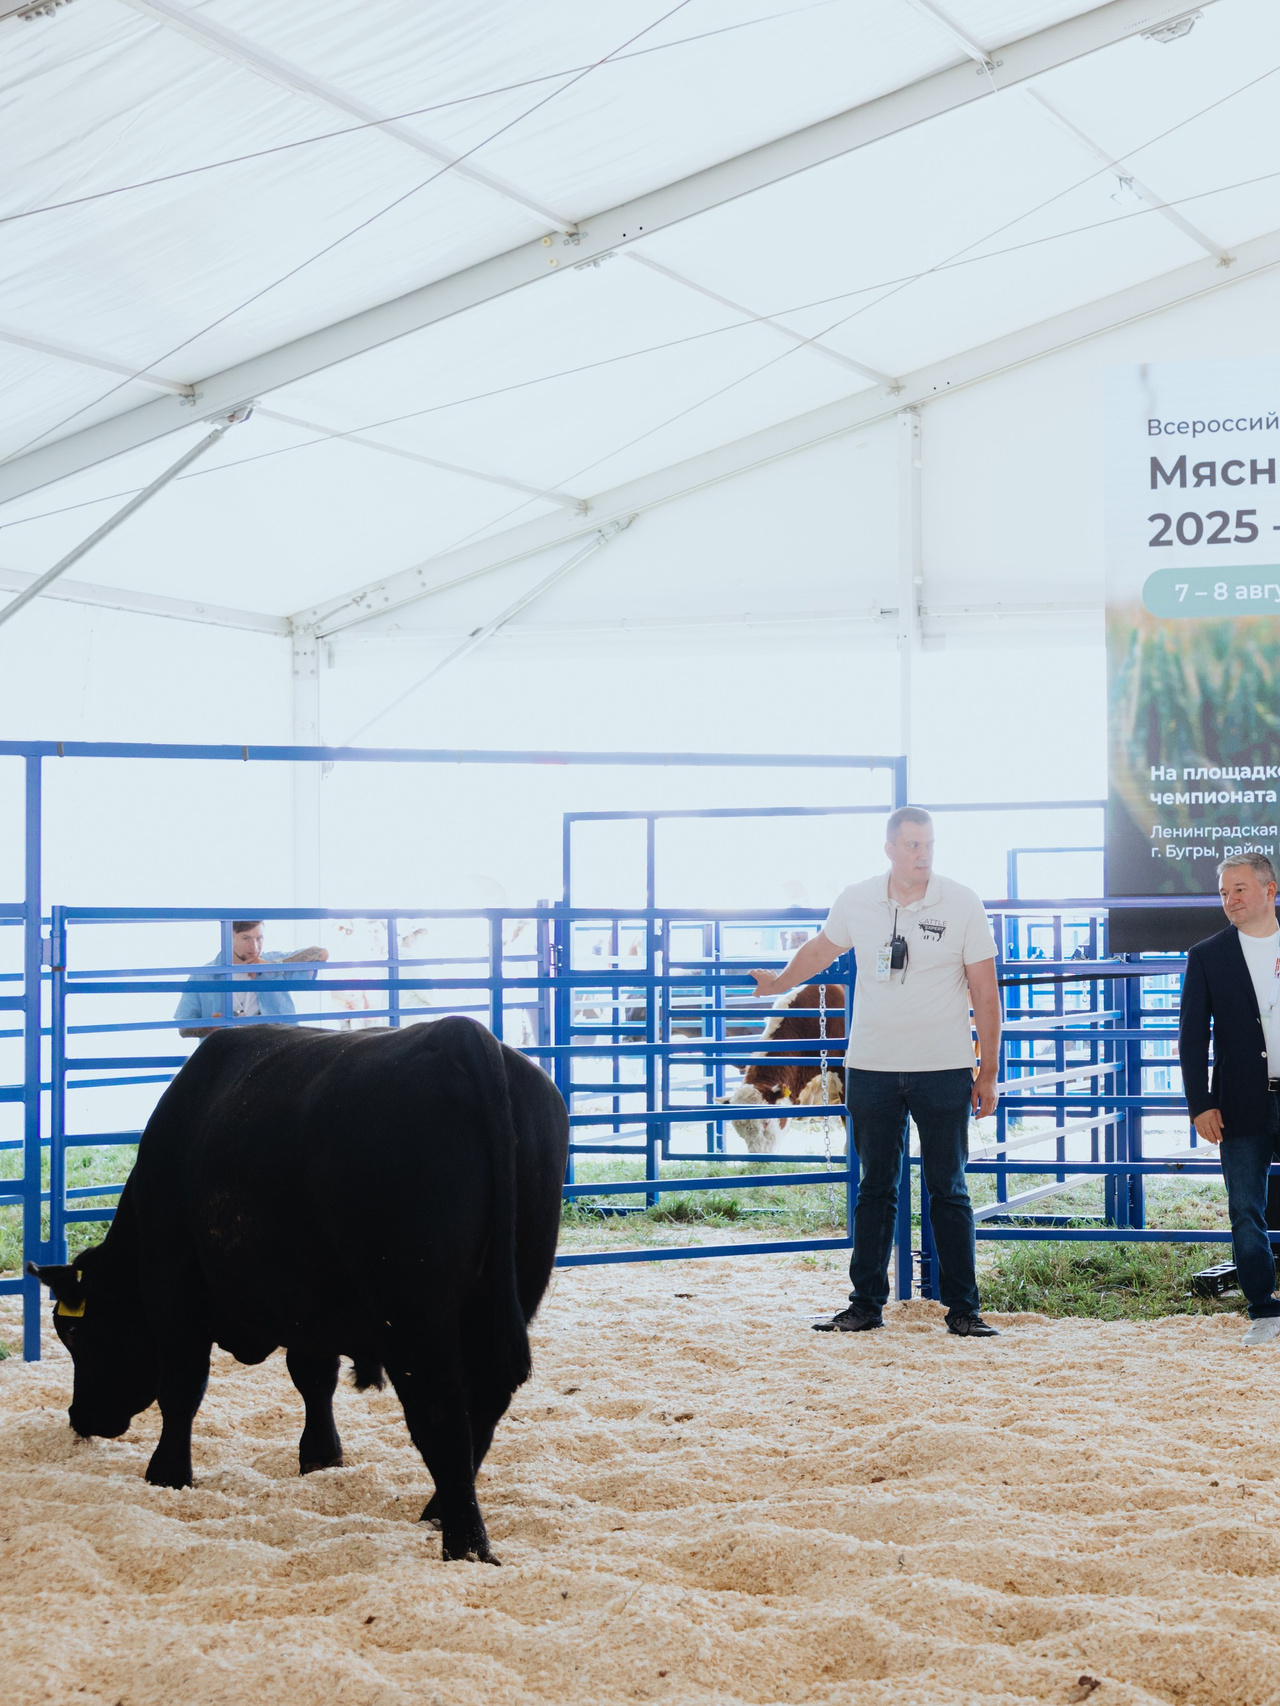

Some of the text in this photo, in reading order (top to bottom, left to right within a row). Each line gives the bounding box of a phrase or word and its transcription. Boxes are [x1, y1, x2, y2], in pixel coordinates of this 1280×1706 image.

[1147, 509, 1260, 547] 2025
[1175, 583, 1189, 603] 7
[1213, 581, 1228, 602] 8
[1150, 765, 1177, 781] На
[1150, 789, 1277, 804] чемпионата
[1150, 824, 1278, 840] Ленинградская
[1151, 847, 1161, 858] г.
[1165, 843, 1219, 860] Бугры,
[1223, 842, 1274, 860] район
[918, 918, 948, 927] CATTLE
